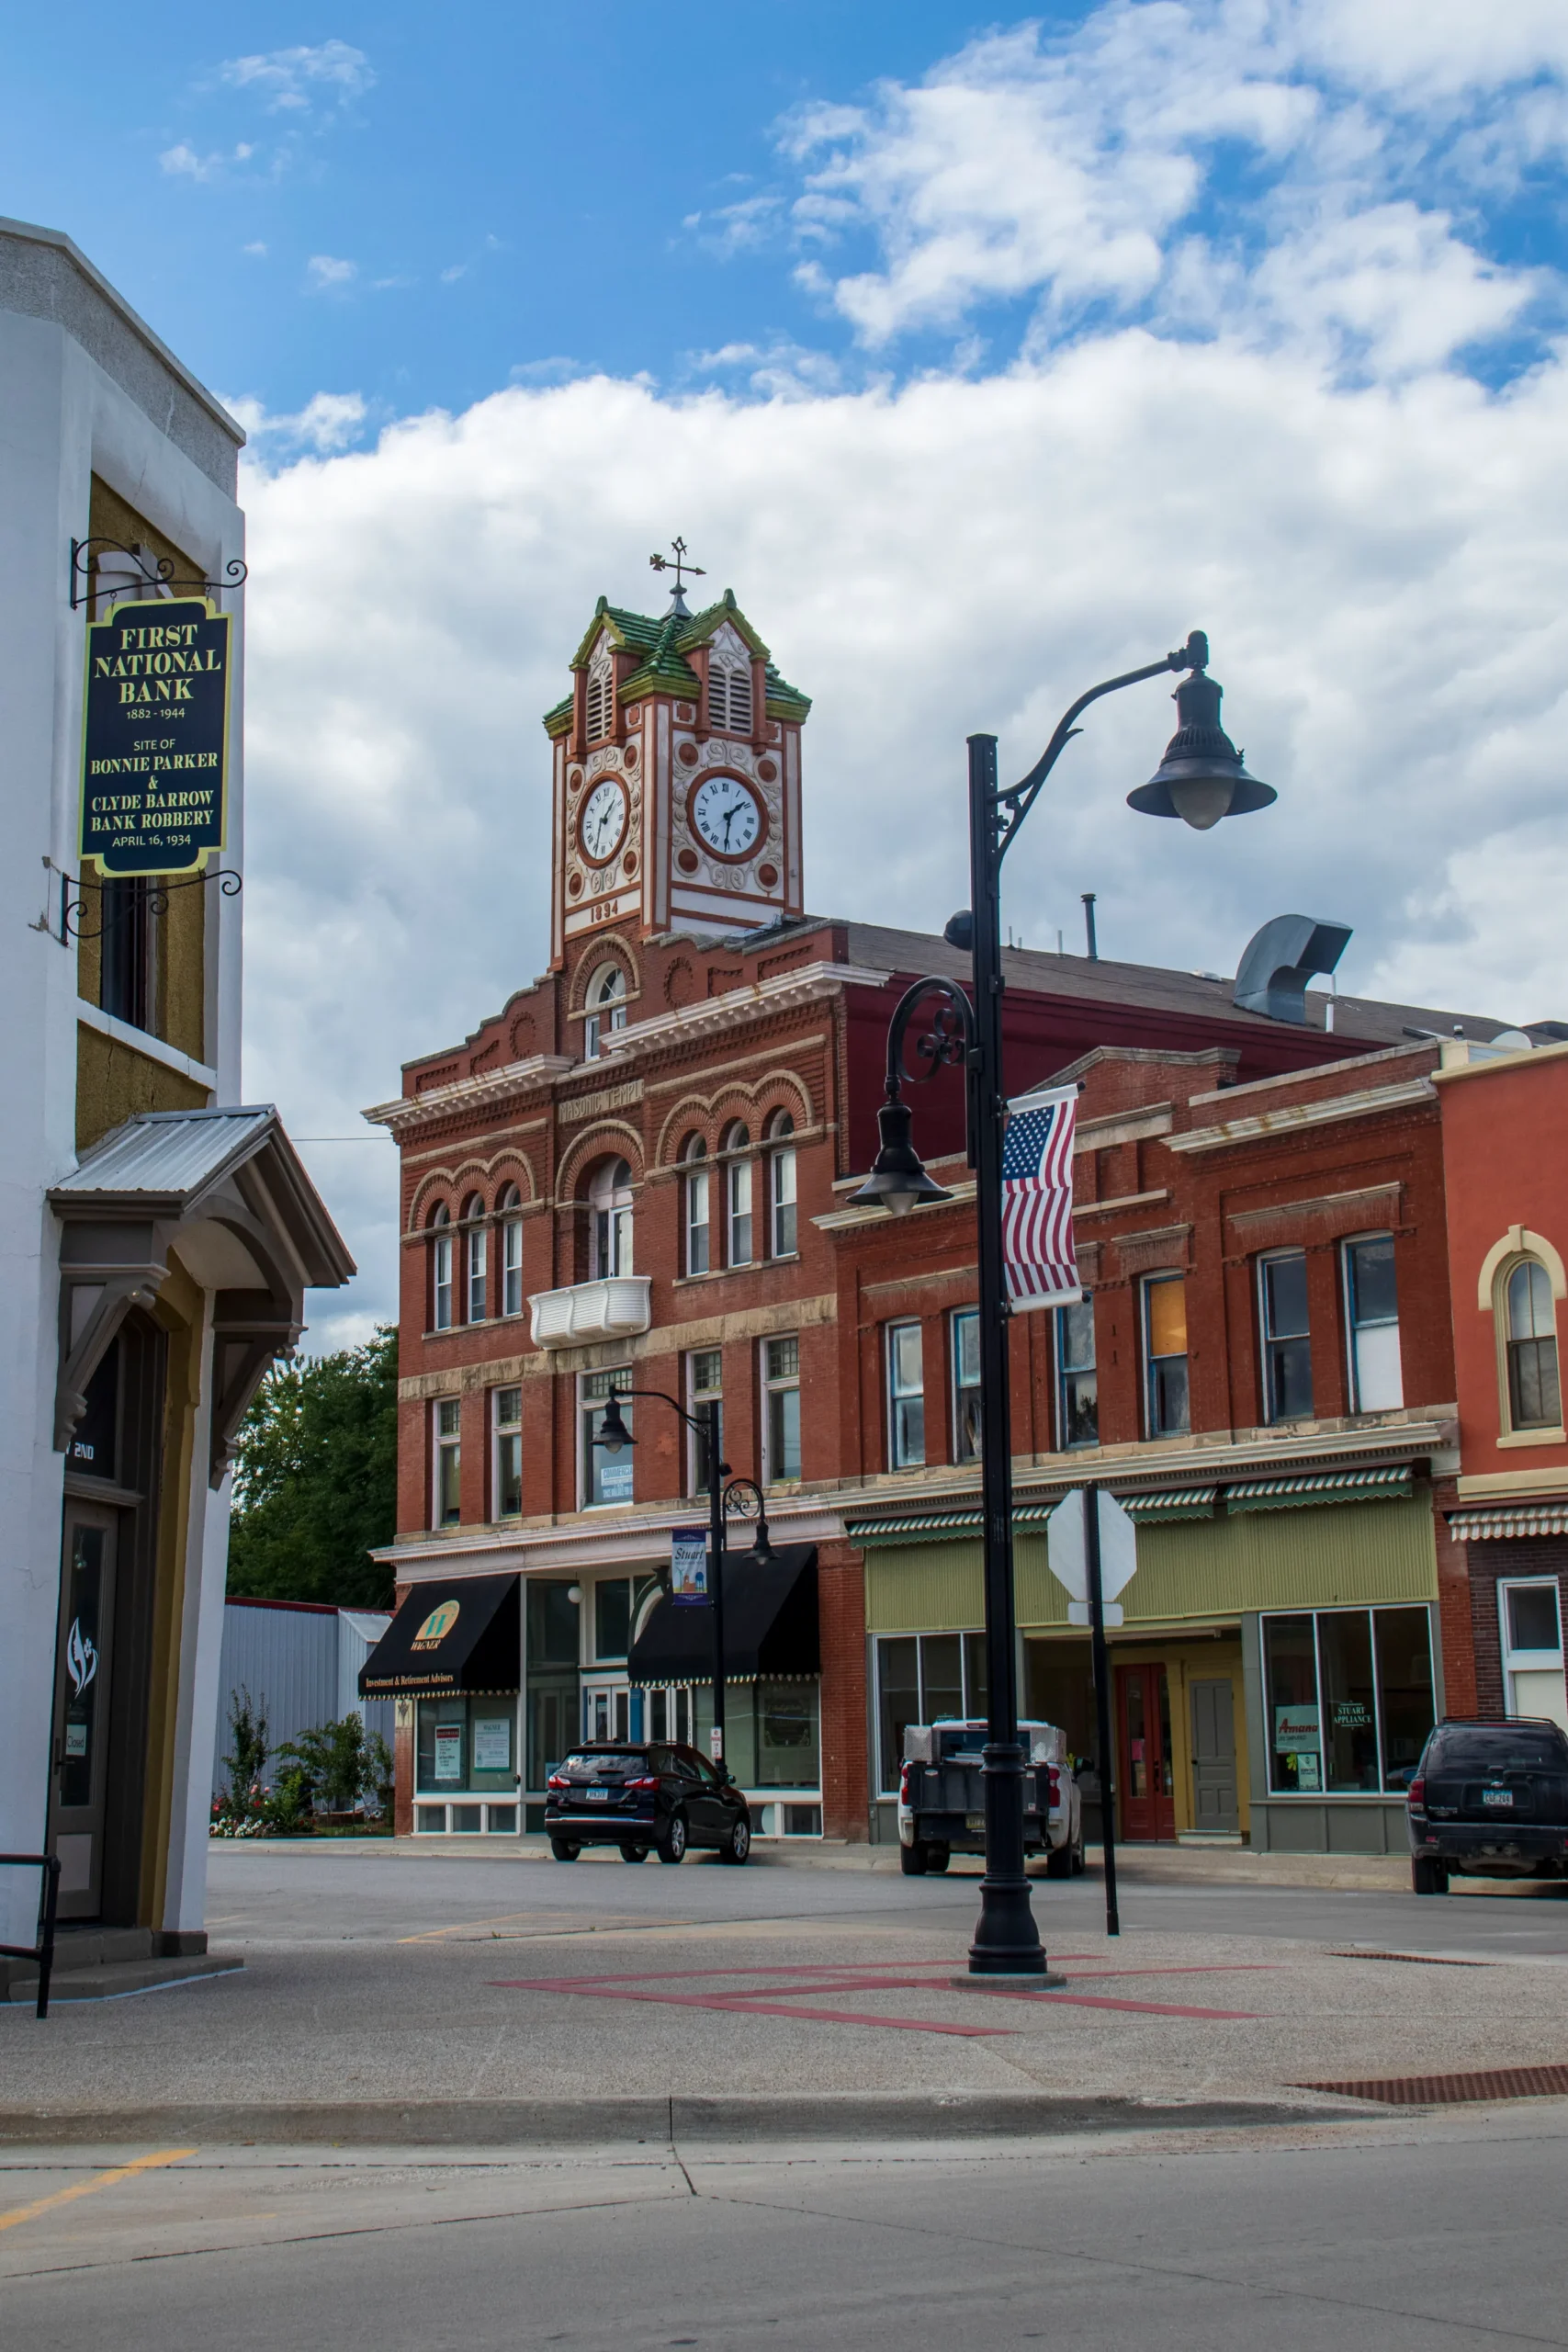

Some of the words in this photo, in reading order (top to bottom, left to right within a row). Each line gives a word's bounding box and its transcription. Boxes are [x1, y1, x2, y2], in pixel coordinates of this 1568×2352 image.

[119, 624, 198, 650] FIRST
[95, 649, 221, 678] NATIONAL
[118, 678, 194, 704] BANK
[127, 708, 151, 719] 1882
[160, 707, 185, 719] 1944
[133, 740, 157, 752] SITE
[160, 739, 175, 750] OF
[91, 756, 150, 775] BONNIE
[153, 752, 218, 771] PARKER
[148, 775, 158, 790] &
[92, 794, 141, 812] CLYDE
[145, 790, 214, 808] BARROW
[91, 815, 136, 831] BANK
[141, 809, 214, 829] ROBBERY
[112, 835, 146, 847] APRIL
[148, 834, 164, 846] 16,
[166, 834, 191, 845] 1934
[591, 899, 618, 923] 1894
[559, 1094, 602, 1121] MASONIC
[74, 1442, 95, 1460] 2ND
[674, 1547, 704, 1560] Stuart
[411, 1639, 442, 1651] WAGNER
[366, 1677, 394, 1688] Investment
[394, 1675, 400, 1686] &
[400, 1674, 430, 1685] Retirement
[430, 1672, 454, 1683] Advisors
[1337, 1706, 1365, 1714] STUART
[1279, 1717, 1319, 1734] Amana
[1334, 1714, 1372, 1724] APPLIANCE
